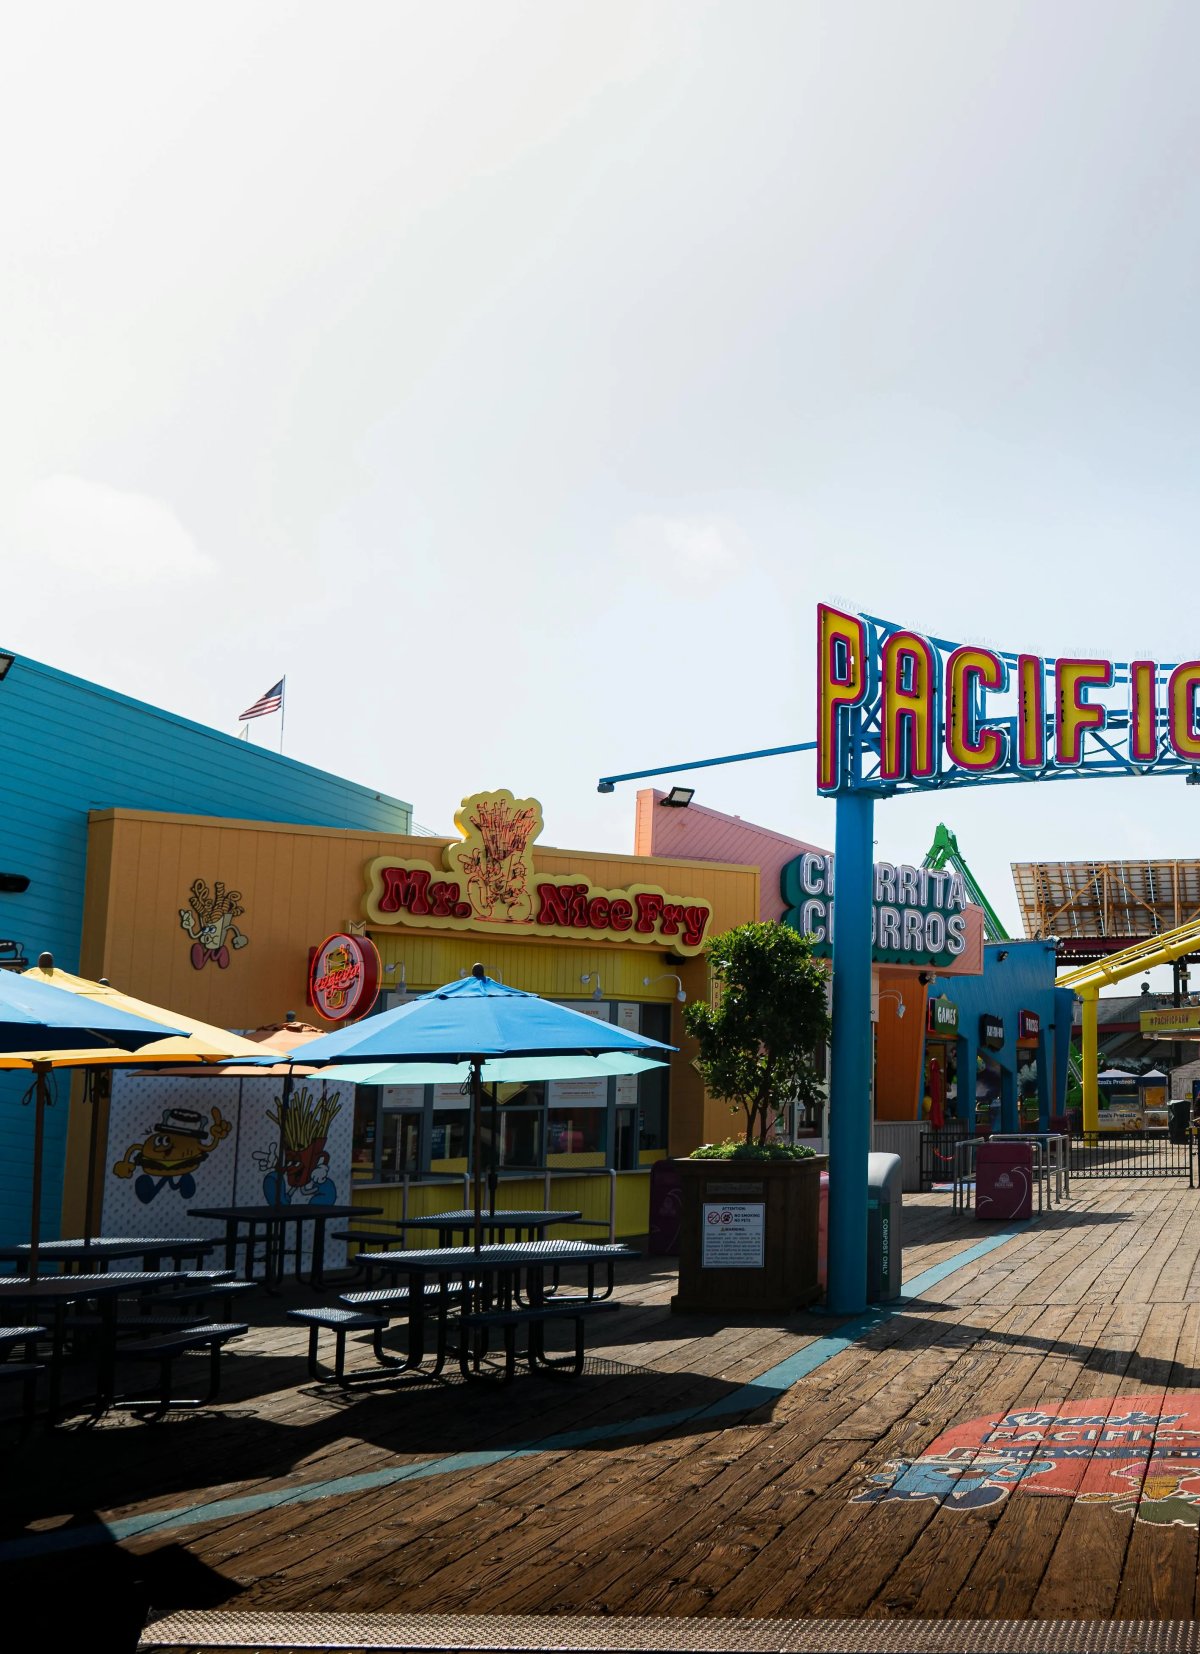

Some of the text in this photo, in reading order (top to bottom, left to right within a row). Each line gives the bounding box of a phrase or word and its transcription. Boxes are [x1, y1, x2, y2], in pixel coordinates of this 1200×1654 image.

[378, 866, 710, 946] Mr. Nice Fry
[801, 852, 966, 910] CRRITA
[803, 898, 966, 955] CRROS
[937, 1006, 956, 1026] GAMES
